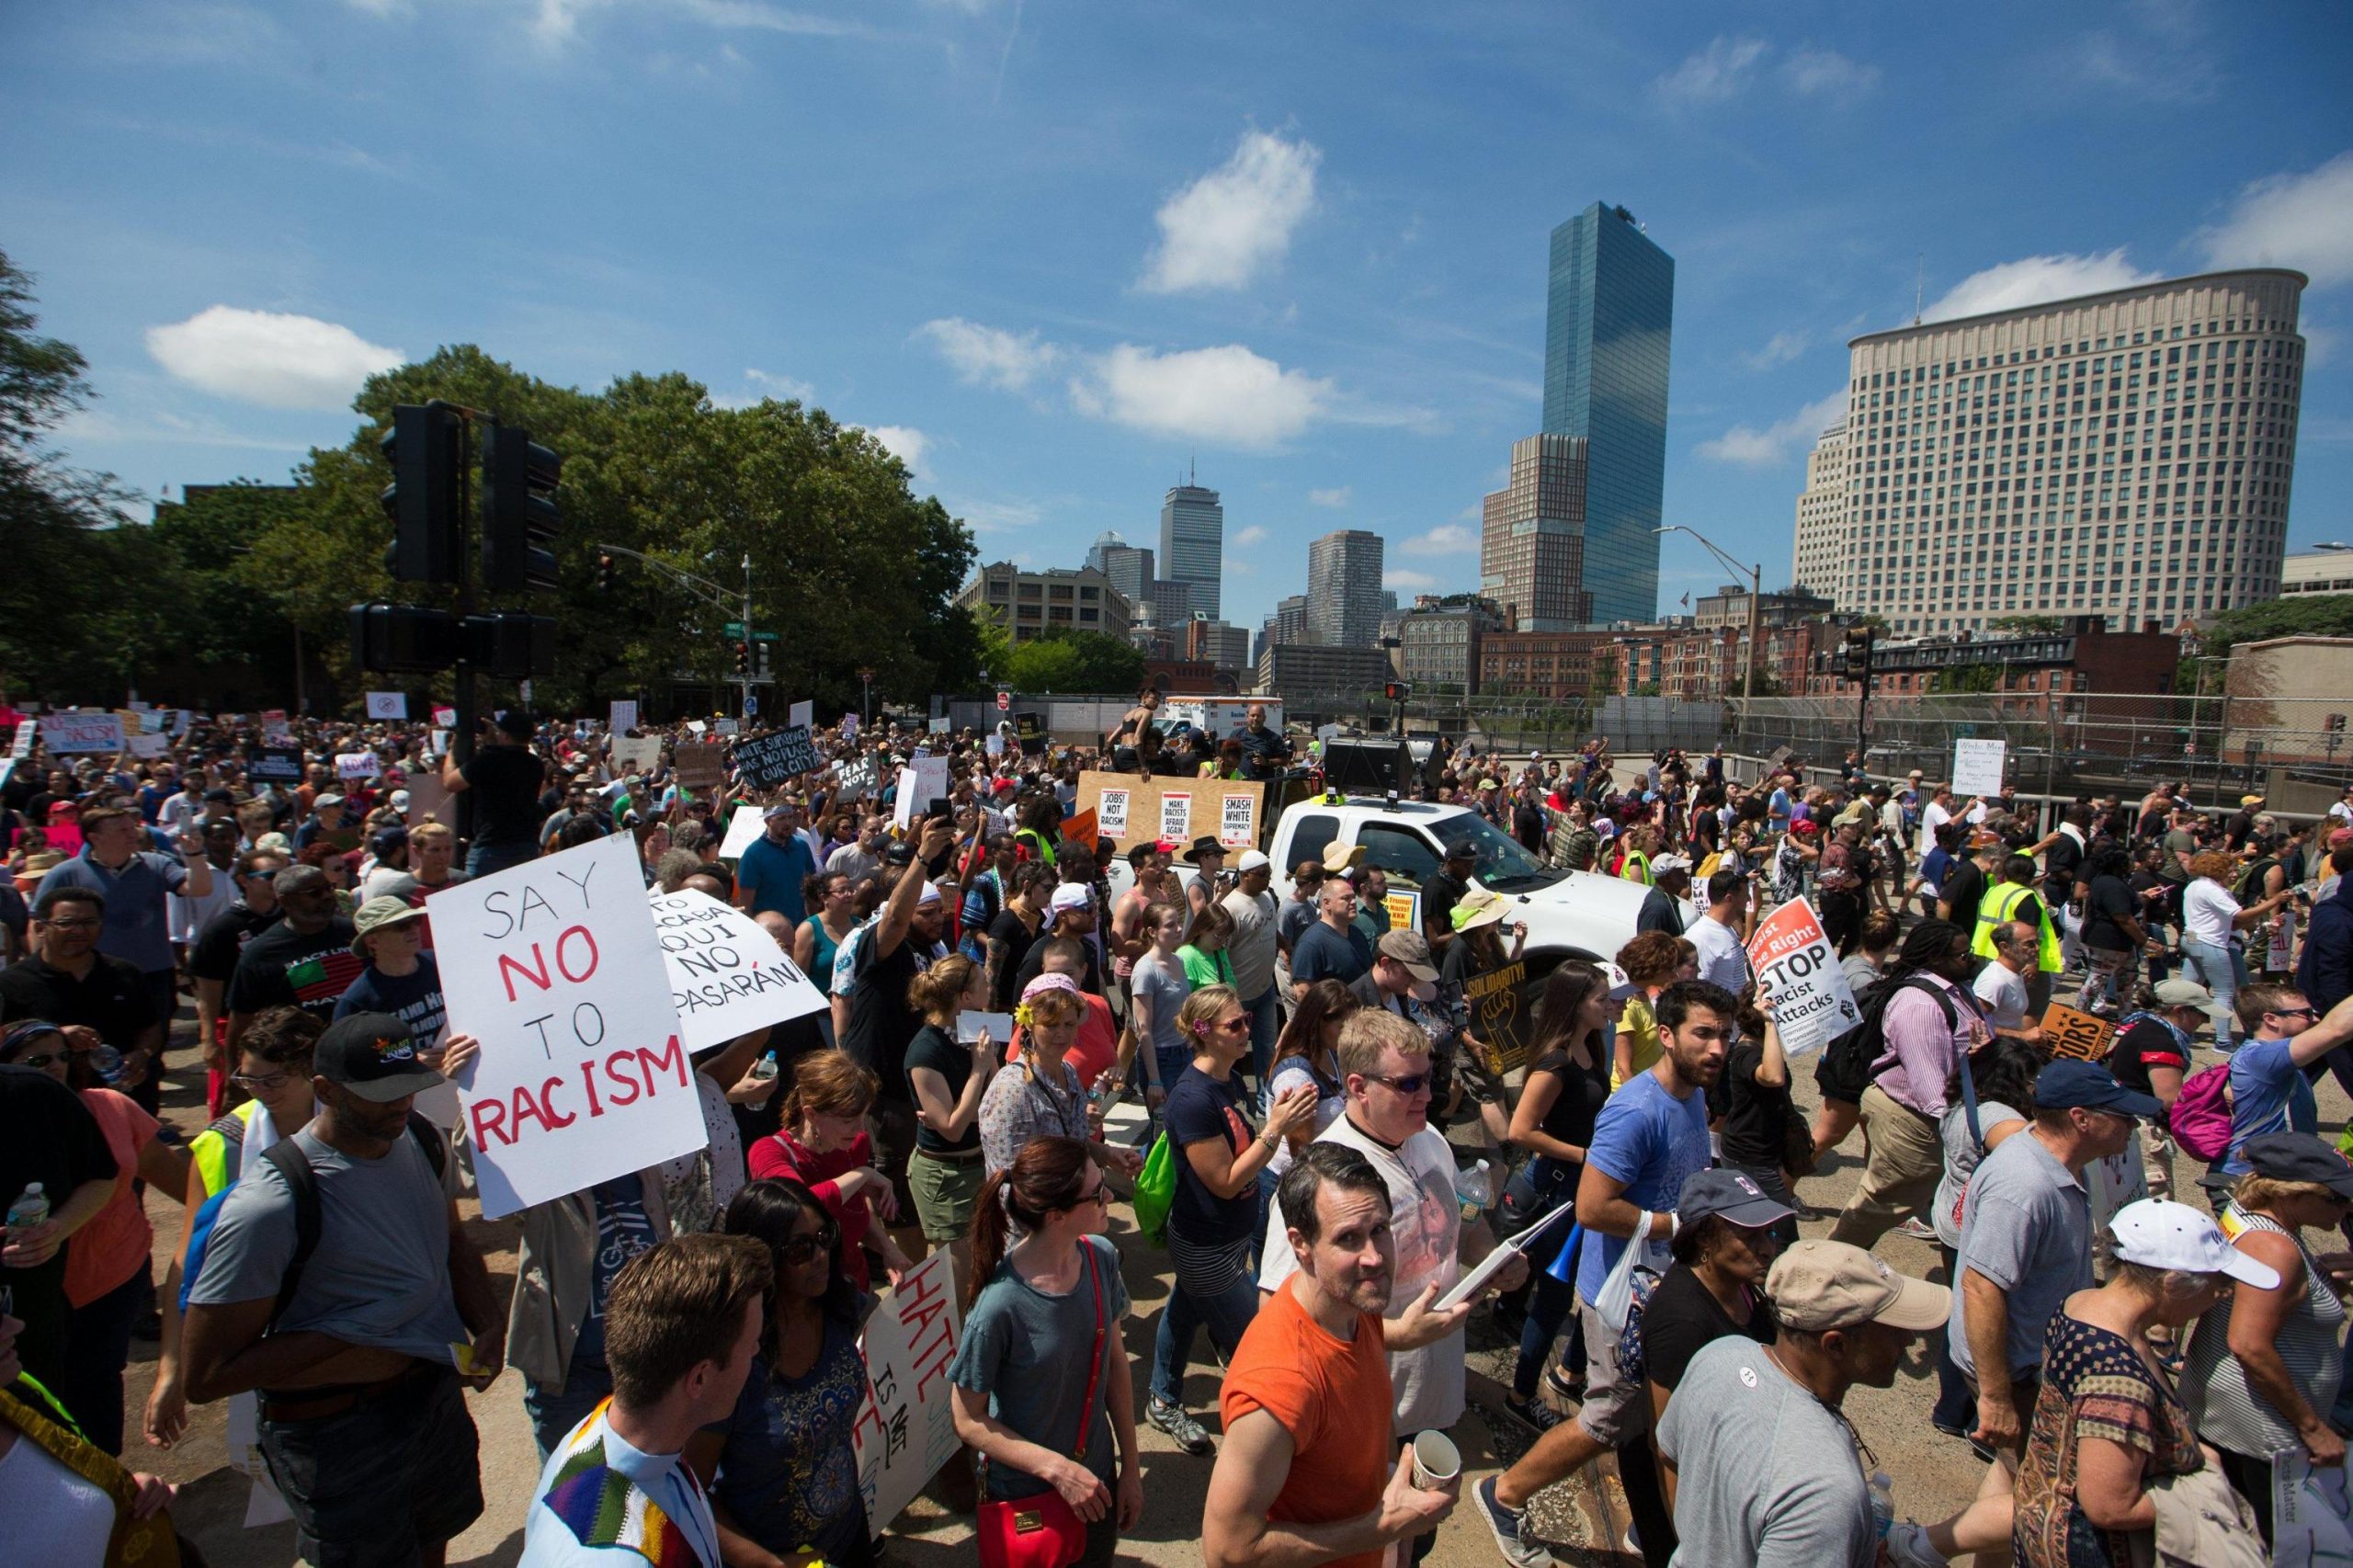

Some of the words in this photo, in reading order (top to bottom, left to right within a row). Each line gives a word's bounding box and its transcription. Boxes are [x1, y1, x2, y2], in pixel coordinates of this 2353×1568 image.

[735, 742, 764, 760] WHITE
[740, 757, 761, 772] HAS
[762, 750, 779, 766] NO
[782, 742, 813, 760] PLACE
[345, 757, 374, 771] LOVE
[762, 764, 788, 781] OUR
[788, 753, 818, 773] CITY!
[838, 757, 870, 780] FEAR
[841, 771, 867, 790] NOT
[1105, 793, 1125, 803] JOBS!
[1107, 805, 1120, 814] NOT
[1225, 800, 1251, 810] SMASH
[1101, 816, 1125, 826] RACISM!
[1165, 809, 1187, 817] RACISTS
[1165, 818, 1185, 826] AFRAID
[1225, 811, 1250, 822] WHITE
[483, 861, 596, 938] SAY
[1389, 897, 1413, 905] Trump!
[1390, 904, 1410, 913] Nazis!
[1750, 922, 1779, 957] Resist
[1769, 925, 1815, 953] Right
[498, 925, 598, 1003] NO
[677, 946, 740, 978] NO
[1758, 945, 1825, 993] STOP
[1467, 962, 1526, 999] SOLIDARITY!
[1776, 993, 1834, 1027] Attacks
[524, 1003, 604, 1060] TO
[1783, 1021, 1815, 1037] International
[1787, 1028, 1819, 1044] Organization
[471, 1034, 688, 1153] RACISM
[898, 1259, 959, 1403] HATE
[874, 1362, 897, 1405] IS
[890, 1403, 909, 1457] NOT
[2283, 1483, 2296, 1524] Matter
